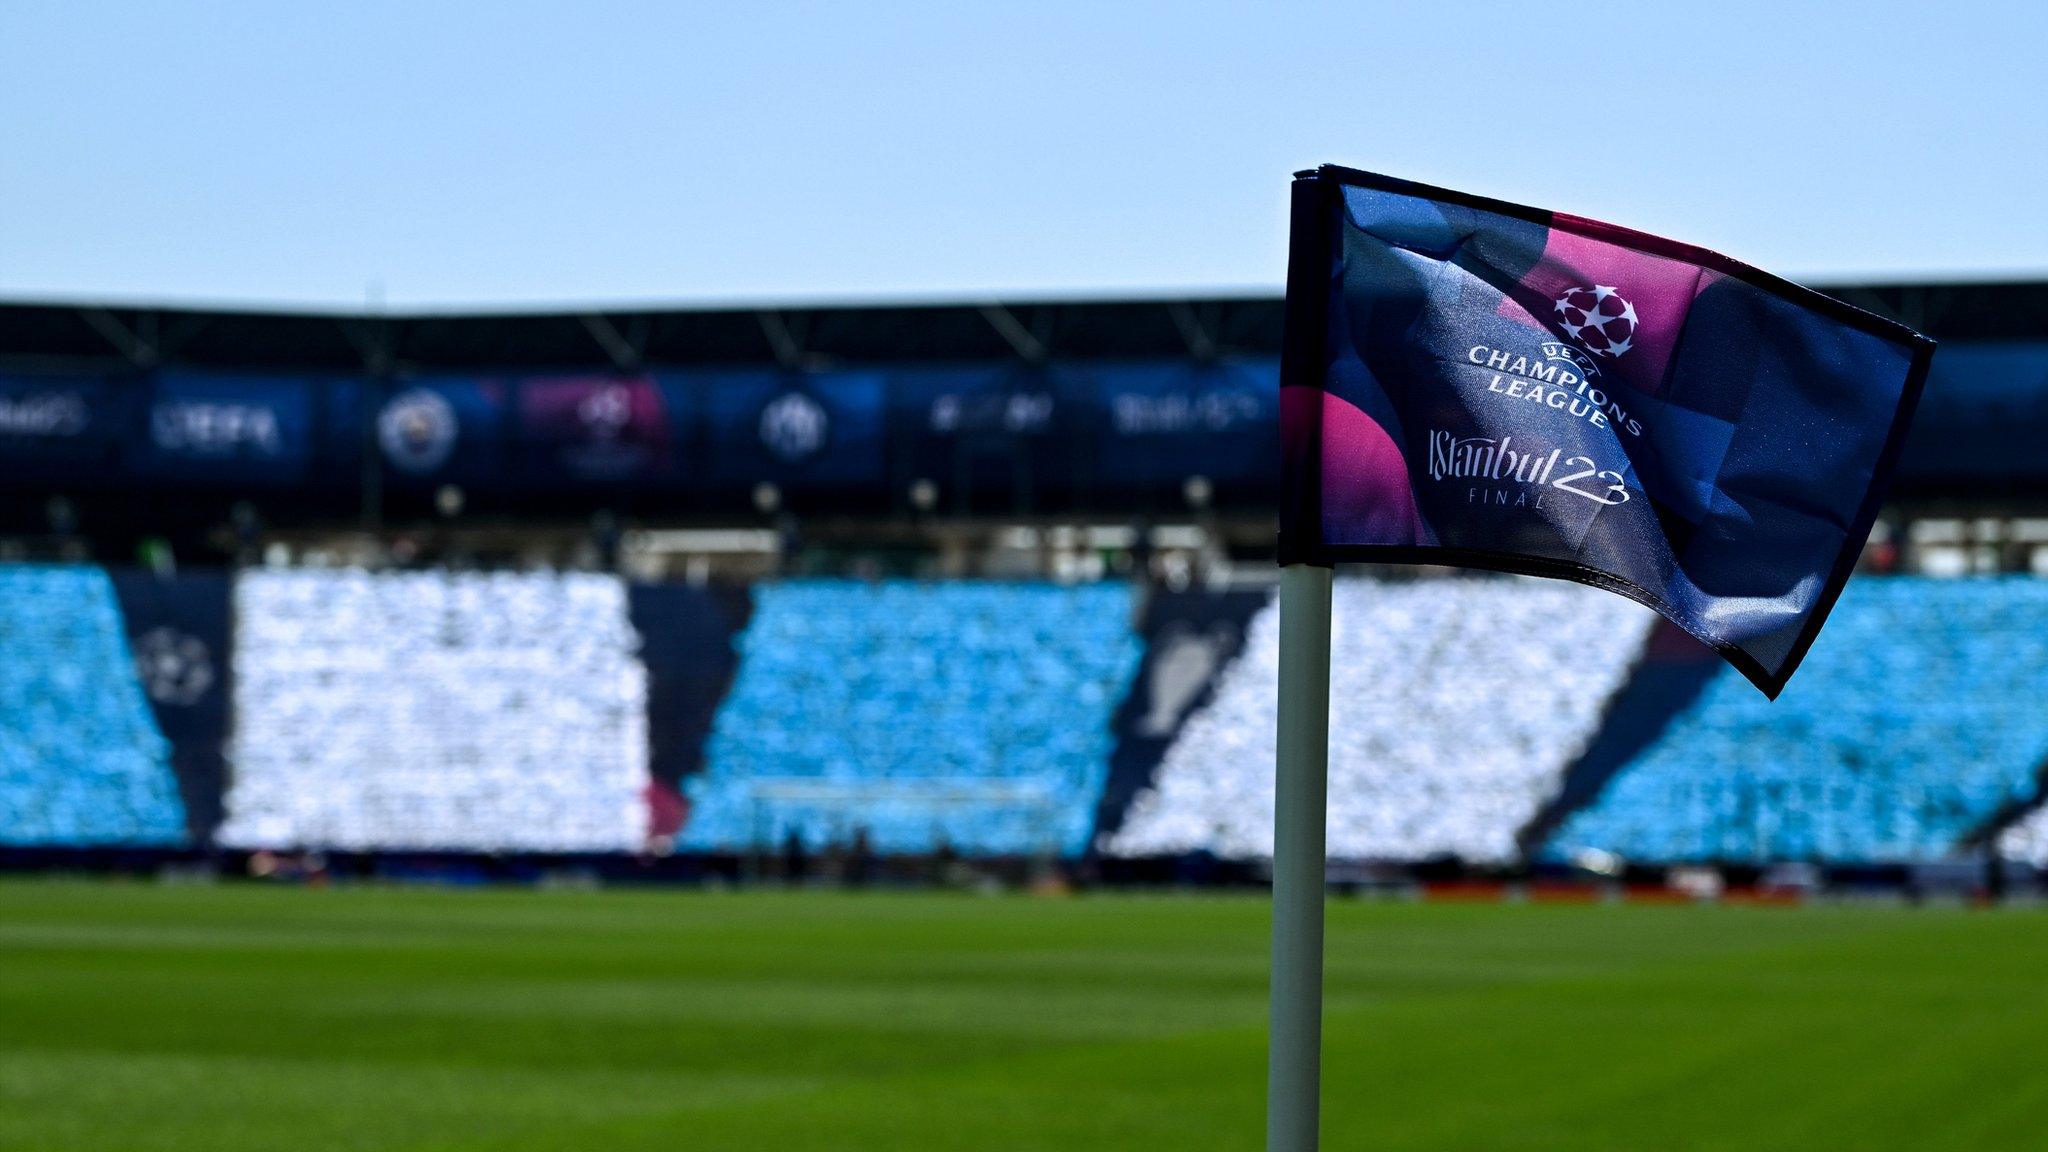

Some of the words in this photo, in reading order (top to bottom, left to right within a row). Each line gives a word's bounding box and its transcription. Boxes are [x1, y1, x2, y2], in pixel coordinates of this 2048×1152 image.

[1542, 345, 1597, 377] UEFA
[1469, 344, 1642, 437] CHAMPIONS
[1488, 375, 1608, 429] LEAGUE
[1469, 487, 1543, 510] FINAL
